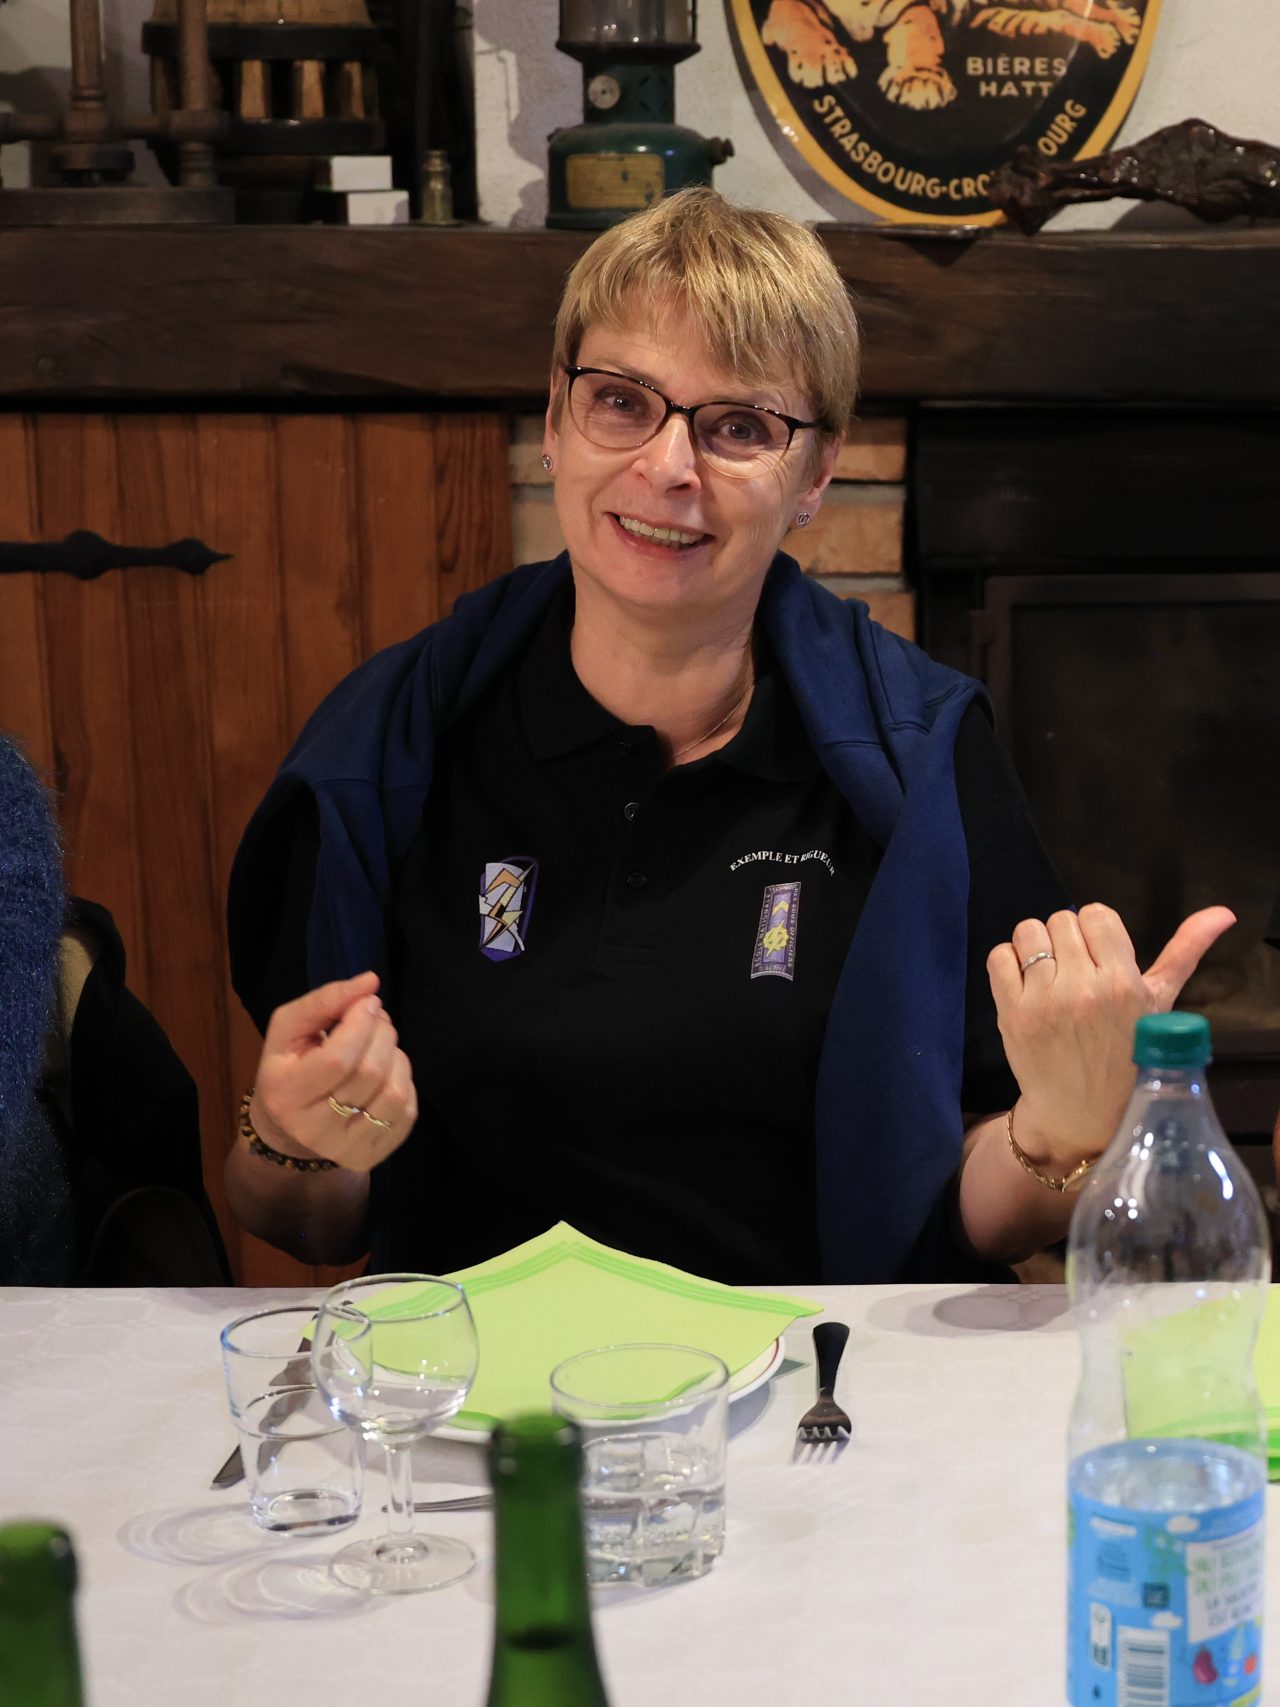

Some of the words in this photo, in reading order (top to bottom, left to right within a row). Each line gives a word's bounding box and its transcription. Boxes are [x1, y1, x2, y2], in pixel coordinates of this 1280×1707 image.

[966, 52, 1068, 76] BIÈRES
[979, 81, 1054, 98] HATT
[729, 851, 783, 871] EXEMPLE
[785, 853, 799, 864] ET
